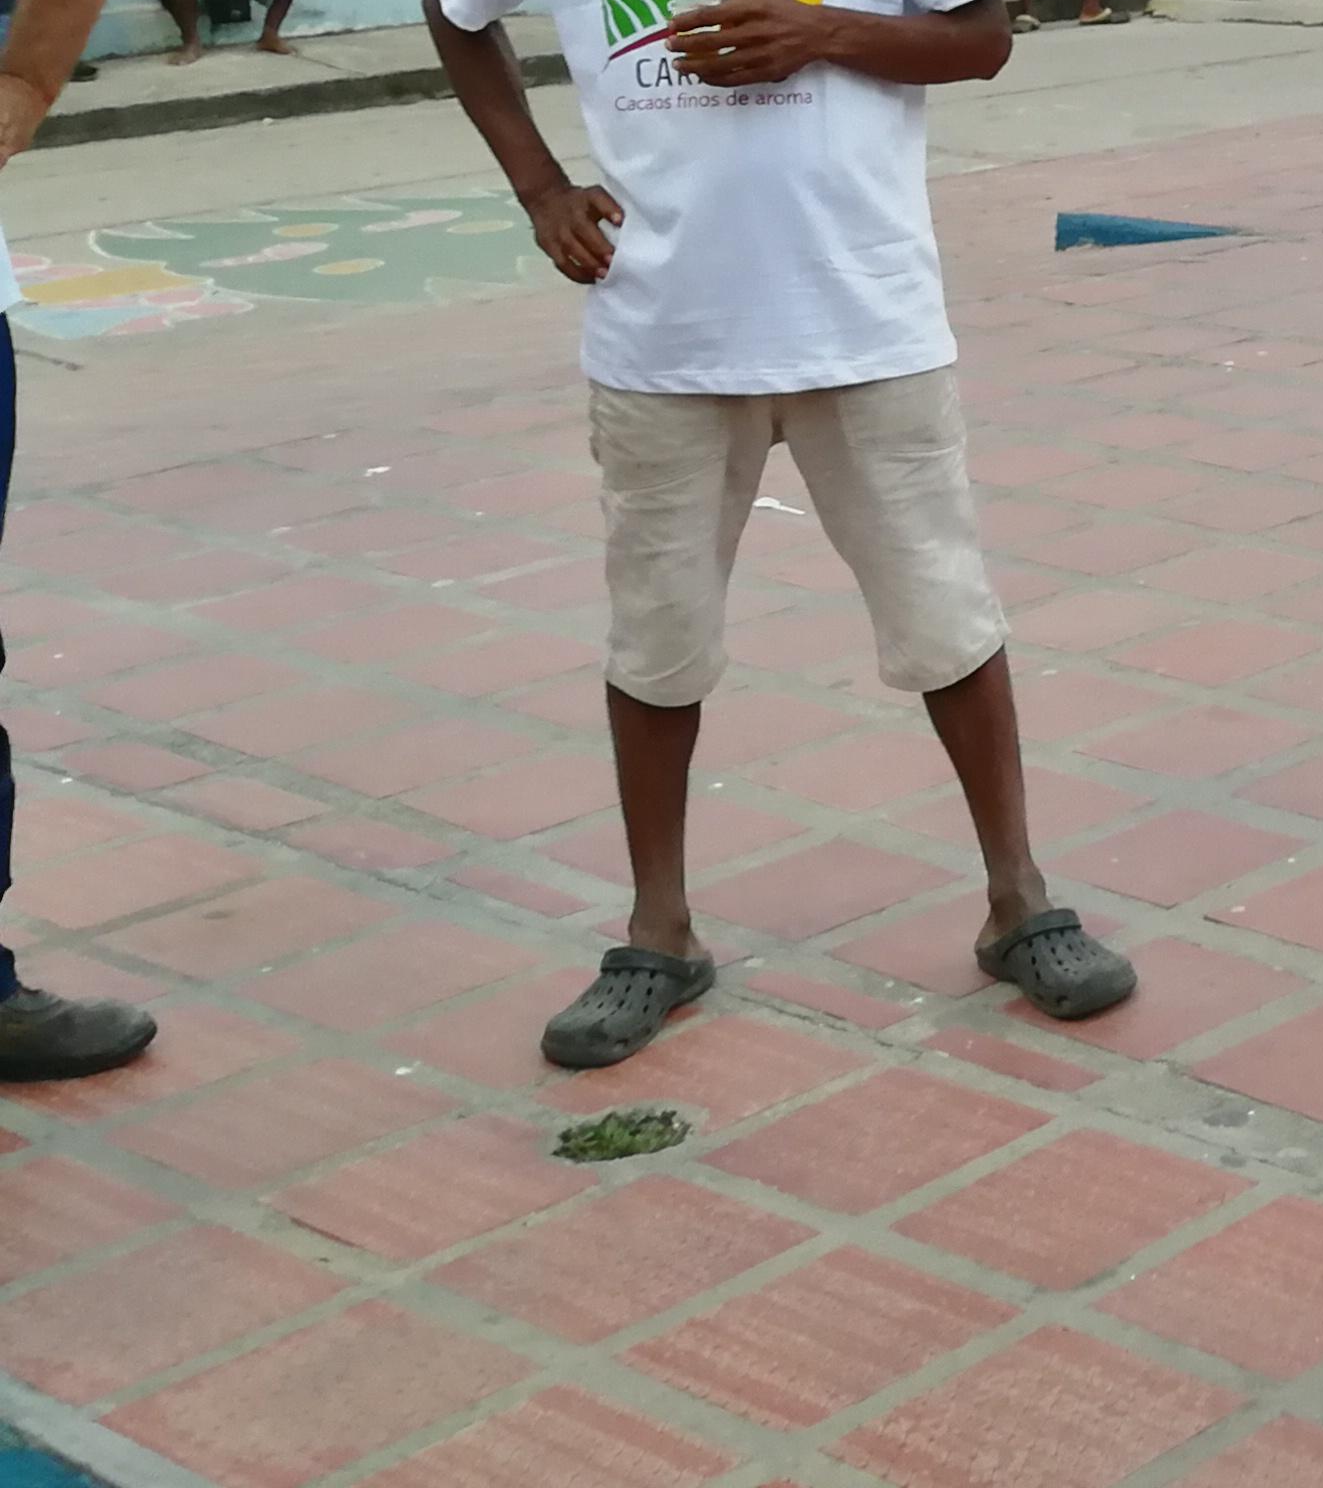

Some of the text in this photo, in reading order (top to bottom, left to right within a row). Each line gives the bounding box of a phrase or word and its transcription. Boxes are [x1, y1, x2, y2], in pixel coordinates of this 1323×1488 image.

[614, 88, 813, 112] Cacaos finos de aroma
